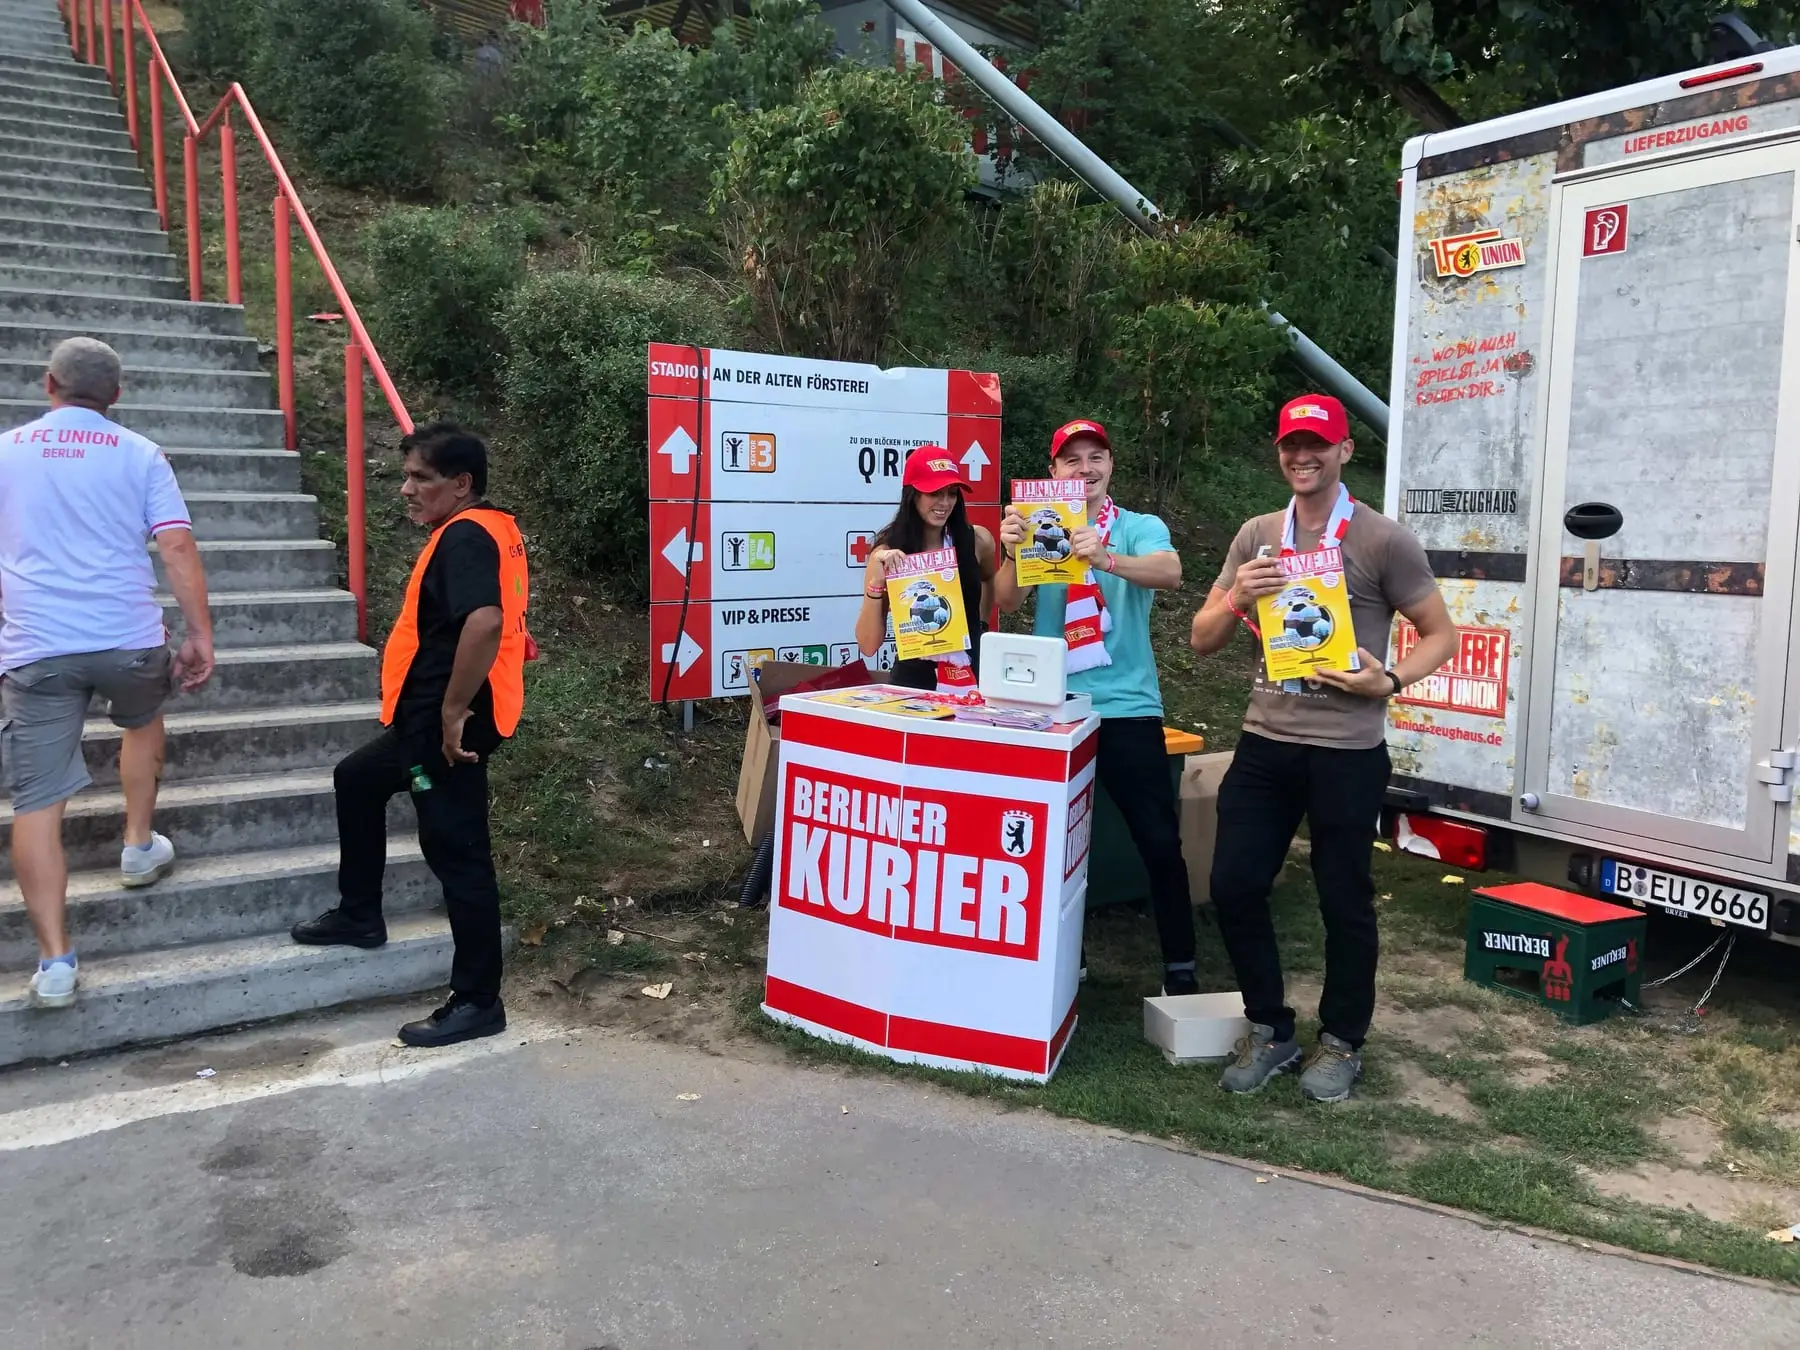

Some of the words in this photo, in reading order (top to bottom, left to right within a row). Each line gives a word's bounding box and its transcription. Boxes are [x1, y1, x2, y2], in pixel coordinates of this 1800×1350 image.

[1624, 115, 1748, 154] LIEFERZUGANG
[1481, 242, 1521, 266] UNION
[1478, 331, 1516, 353] AUCH
[651, 360, 708, 380] STADION
[713, 368, 732, 382] AN
[737, 370, 761, 385] DER
[765, 372, 802, 389] ALTEN
[807, 374, 869, 394] FÖRSTEREI
[14, 431, 24, 444] 1.
[31, 429, 53, 443] FC
[58, 429, 119, 447] UNION
[850, 436, 858, 444] ZU
[860, 437, 873, 445] DEN
[874, 437, 901, 447] BLÖCKEN
[42, 448, 85, 459] BERLIN
[757, 440, 772, 468] 3
[1406, 489, 1442, 513] UNION
[1442, 491, 1456, 512] FAHR
[1456, 490, 1517, 513] ZEUGHAUS
[756, 539, 774, 565] 4
[722, 609, 745, 625] VIP
[747, 609, 759, 624] &
[762, 607, 810, 624] PRESSE
[1438, 631, 1501, 679] IEBE
[1452, 677, 1498, 710] UNION
[1395, 719, 1503, 746] union-zeughaus.de
[793, 776, 947, 847] BERLINER
[788, 821, 1030, 946] KURIER
[1605, 878, 1611, 887] D
[1617, 866, 1632, 892] B
[1651, 874, 1686, 907] EU
[1694, 884, 1765, 924] 9666
[1484, 931, 1551, 958] BERLINER
[1591, 946, 1627, 971] BERLINER
